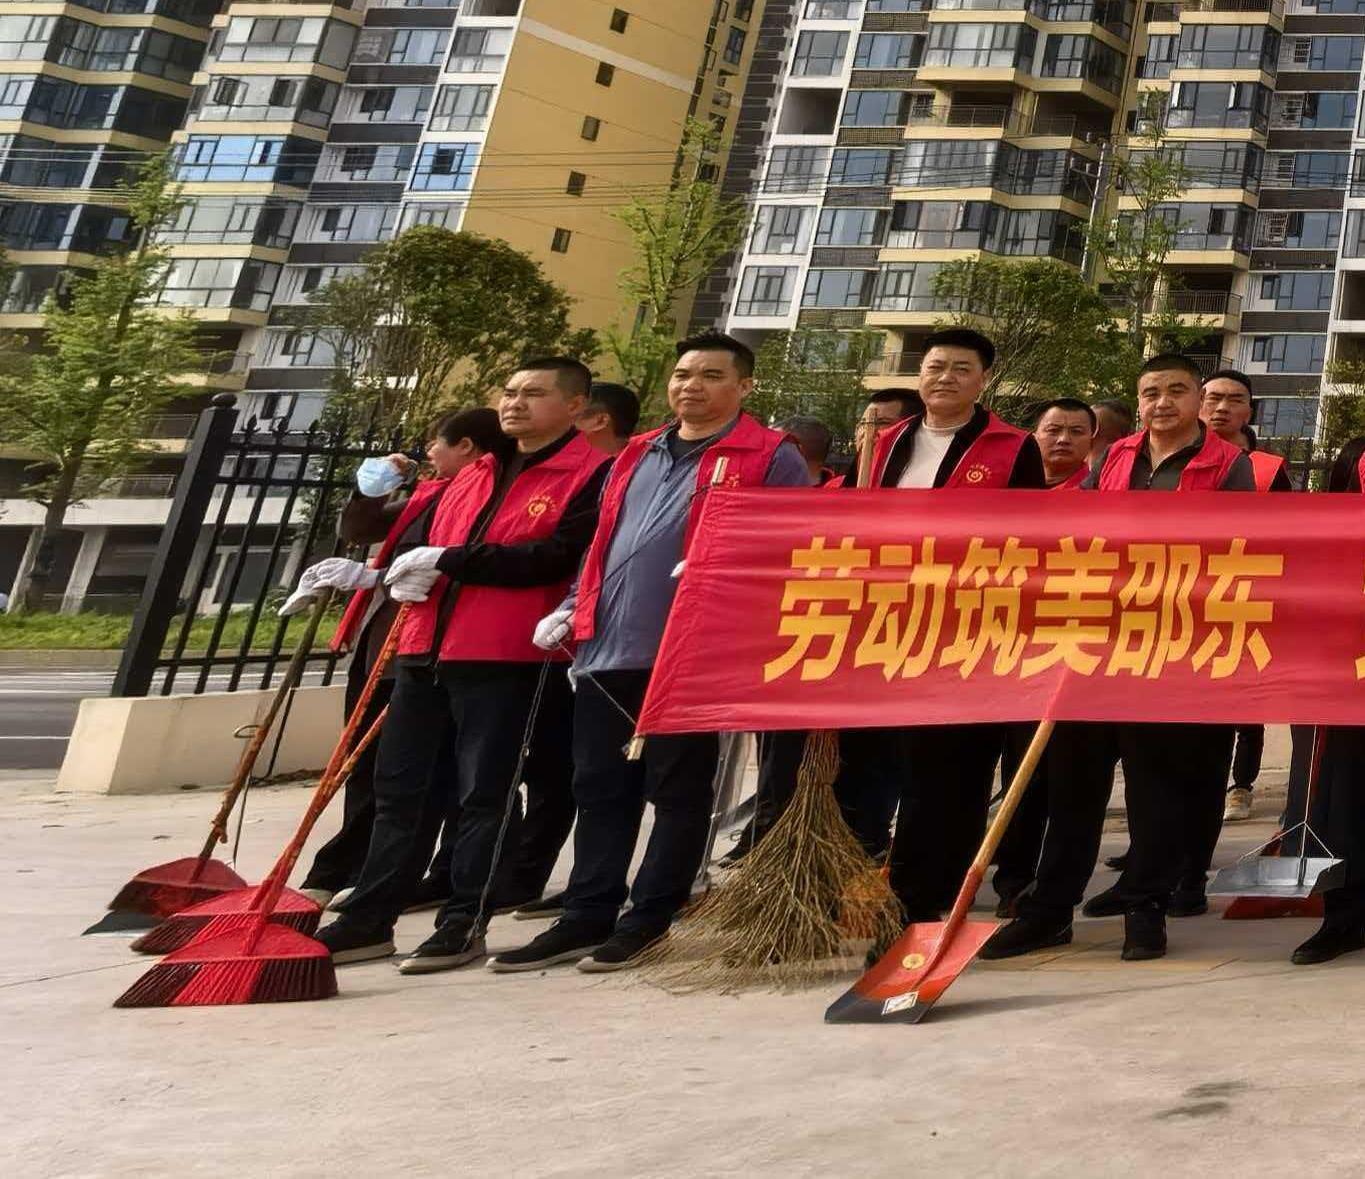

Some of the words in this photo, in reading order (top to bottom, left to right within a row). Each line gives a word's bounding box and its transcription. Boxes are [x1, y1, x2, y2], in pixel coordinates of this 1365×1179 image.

[764, 537, 1284, 682] 劳动筑美邵东
